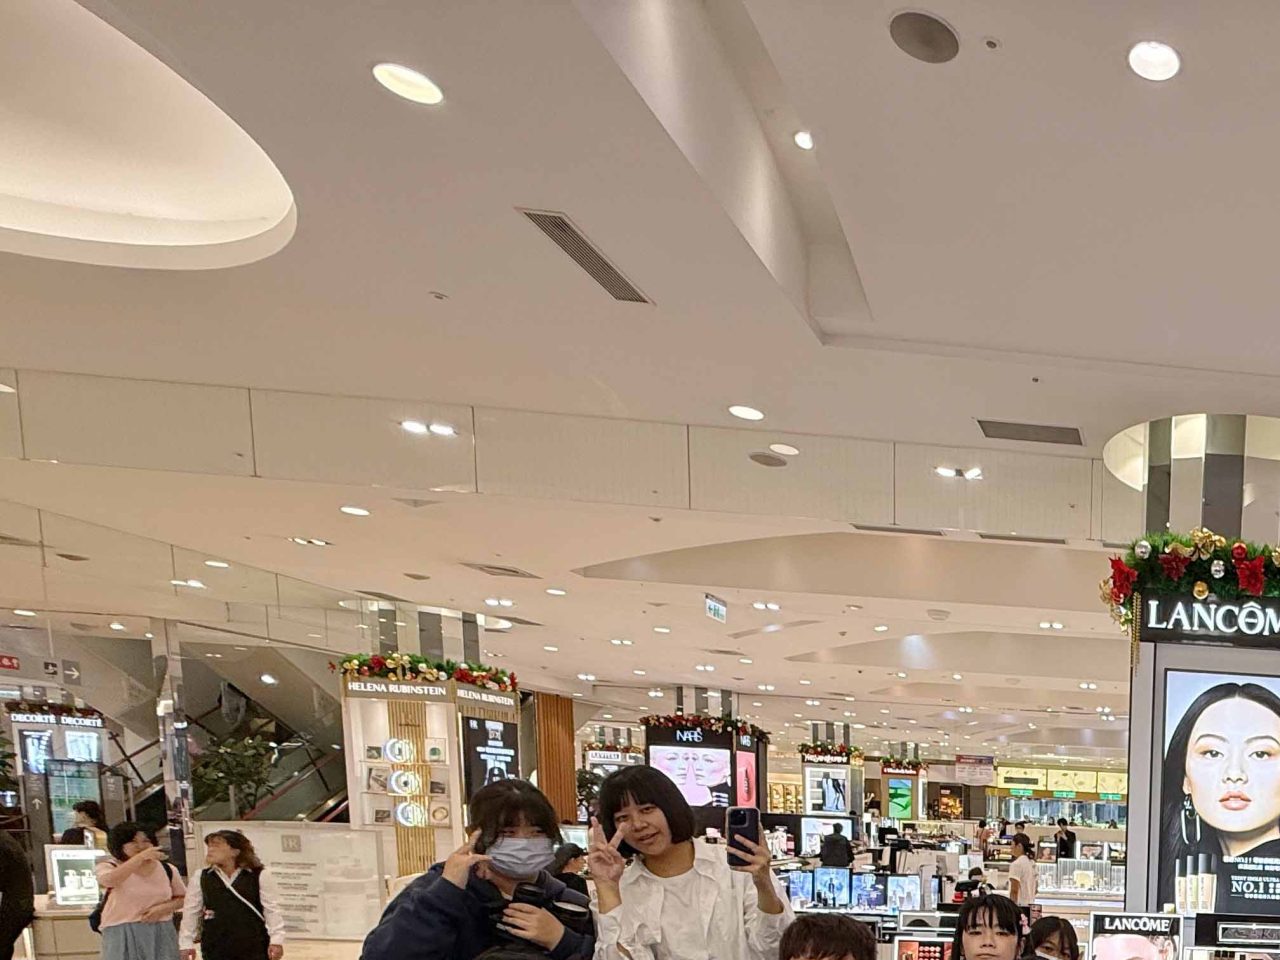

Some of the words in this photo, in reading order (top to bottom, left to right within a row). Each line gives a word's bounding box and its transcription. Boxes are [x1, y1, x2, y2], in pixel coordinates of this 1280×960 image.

[348, 682, 387, 693] HELENA
[388, 684, 447, 696] RUBINSTEIN
[457, 688, 481, 701] HELENA
[481, 693, 514, 706] RUBINSTEIN
[676, 728, 703, 743] NARS
[1231, 881, 1265, 893] NO.1
[1104, 917, 1170, 932] LANCÔME
